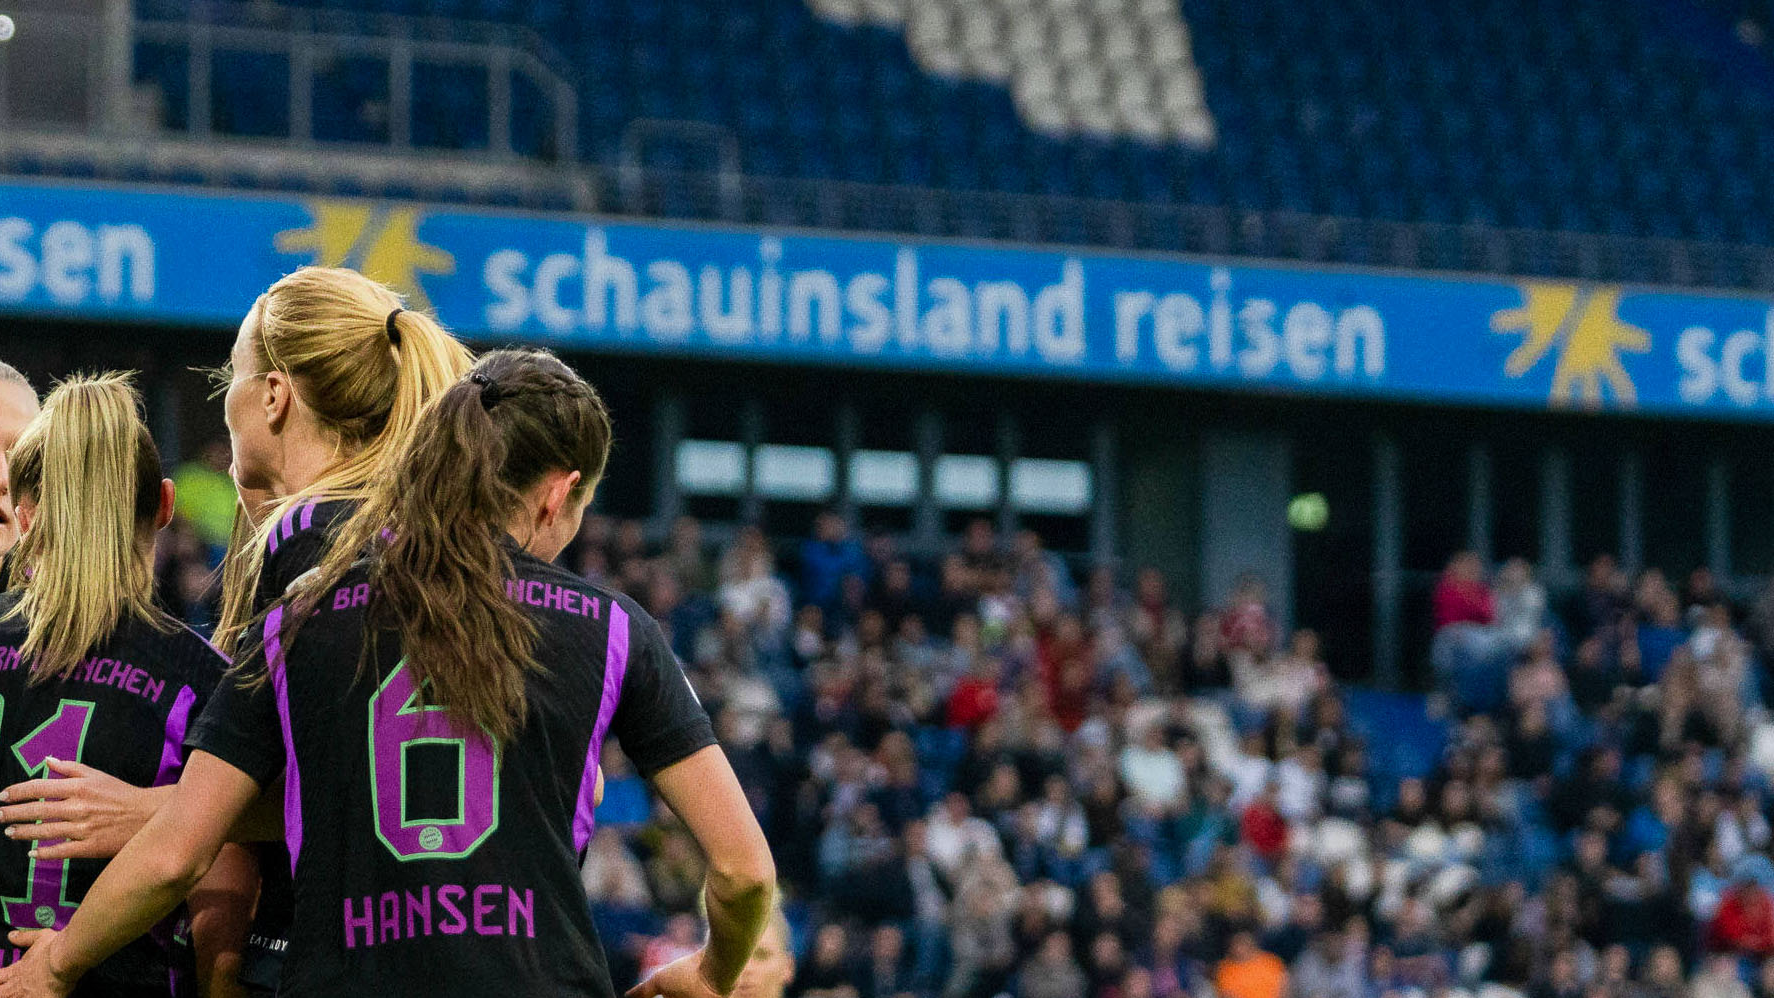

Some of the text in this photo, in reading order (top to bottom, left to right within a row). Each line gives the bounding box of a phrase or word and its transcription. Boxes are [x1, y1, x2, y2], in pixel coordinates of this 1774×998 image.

[482, 228, 1387, 380] schauinsland reisen
[1676, 308, 1774, 406] sc
[506, 579, 600, 620] NCHEN
[368, 654, 501, 862] 6
[343, 883, 536, 949] HANSEN
